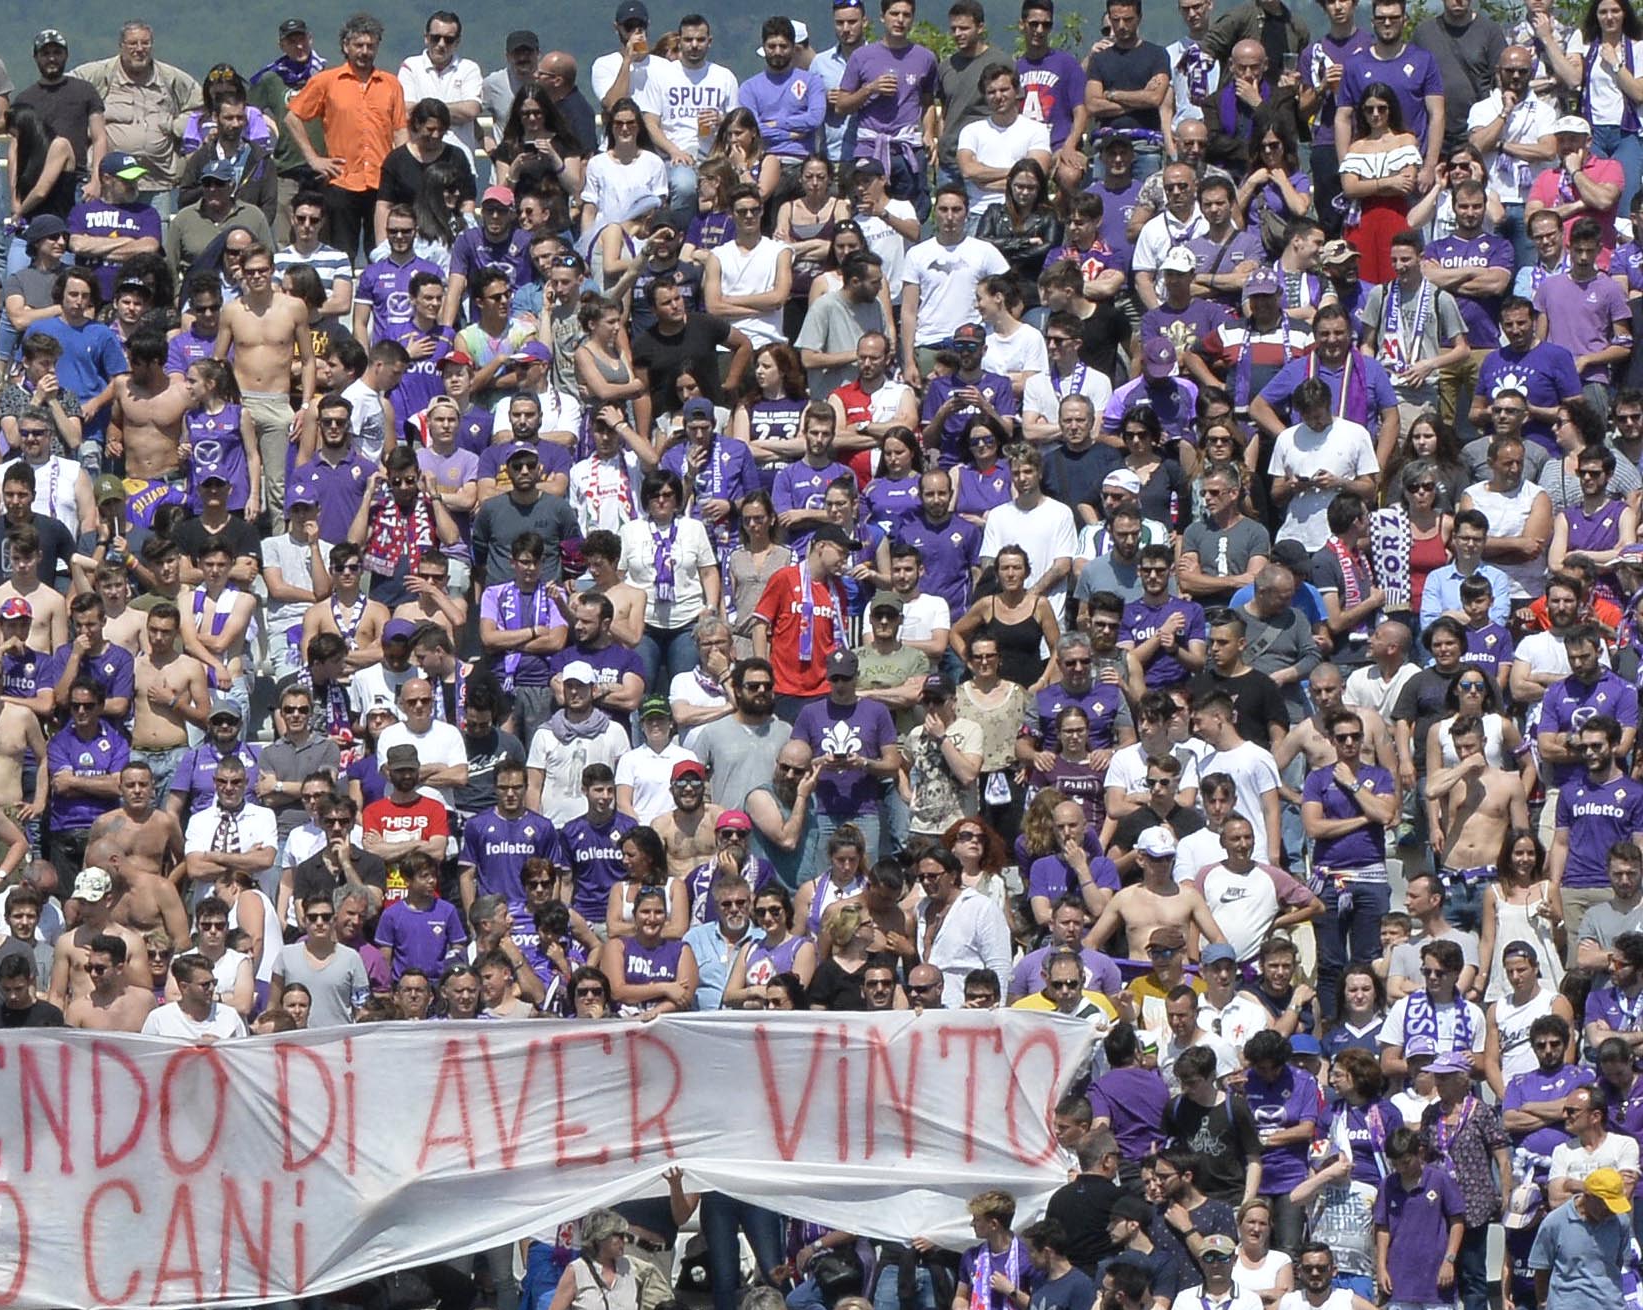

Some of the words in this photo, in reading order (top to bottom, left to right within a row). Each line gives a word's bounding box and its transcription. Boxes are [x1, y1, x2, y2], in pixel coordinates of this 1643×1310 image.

[669, 86, 721, 108] SPUTI
[1572, 801, 1625, 819] folletto
[486, 841, 535, 856] folletto
[576, 847, 624, 862] folletto
[417, 1030, 682, 1170] AVER
